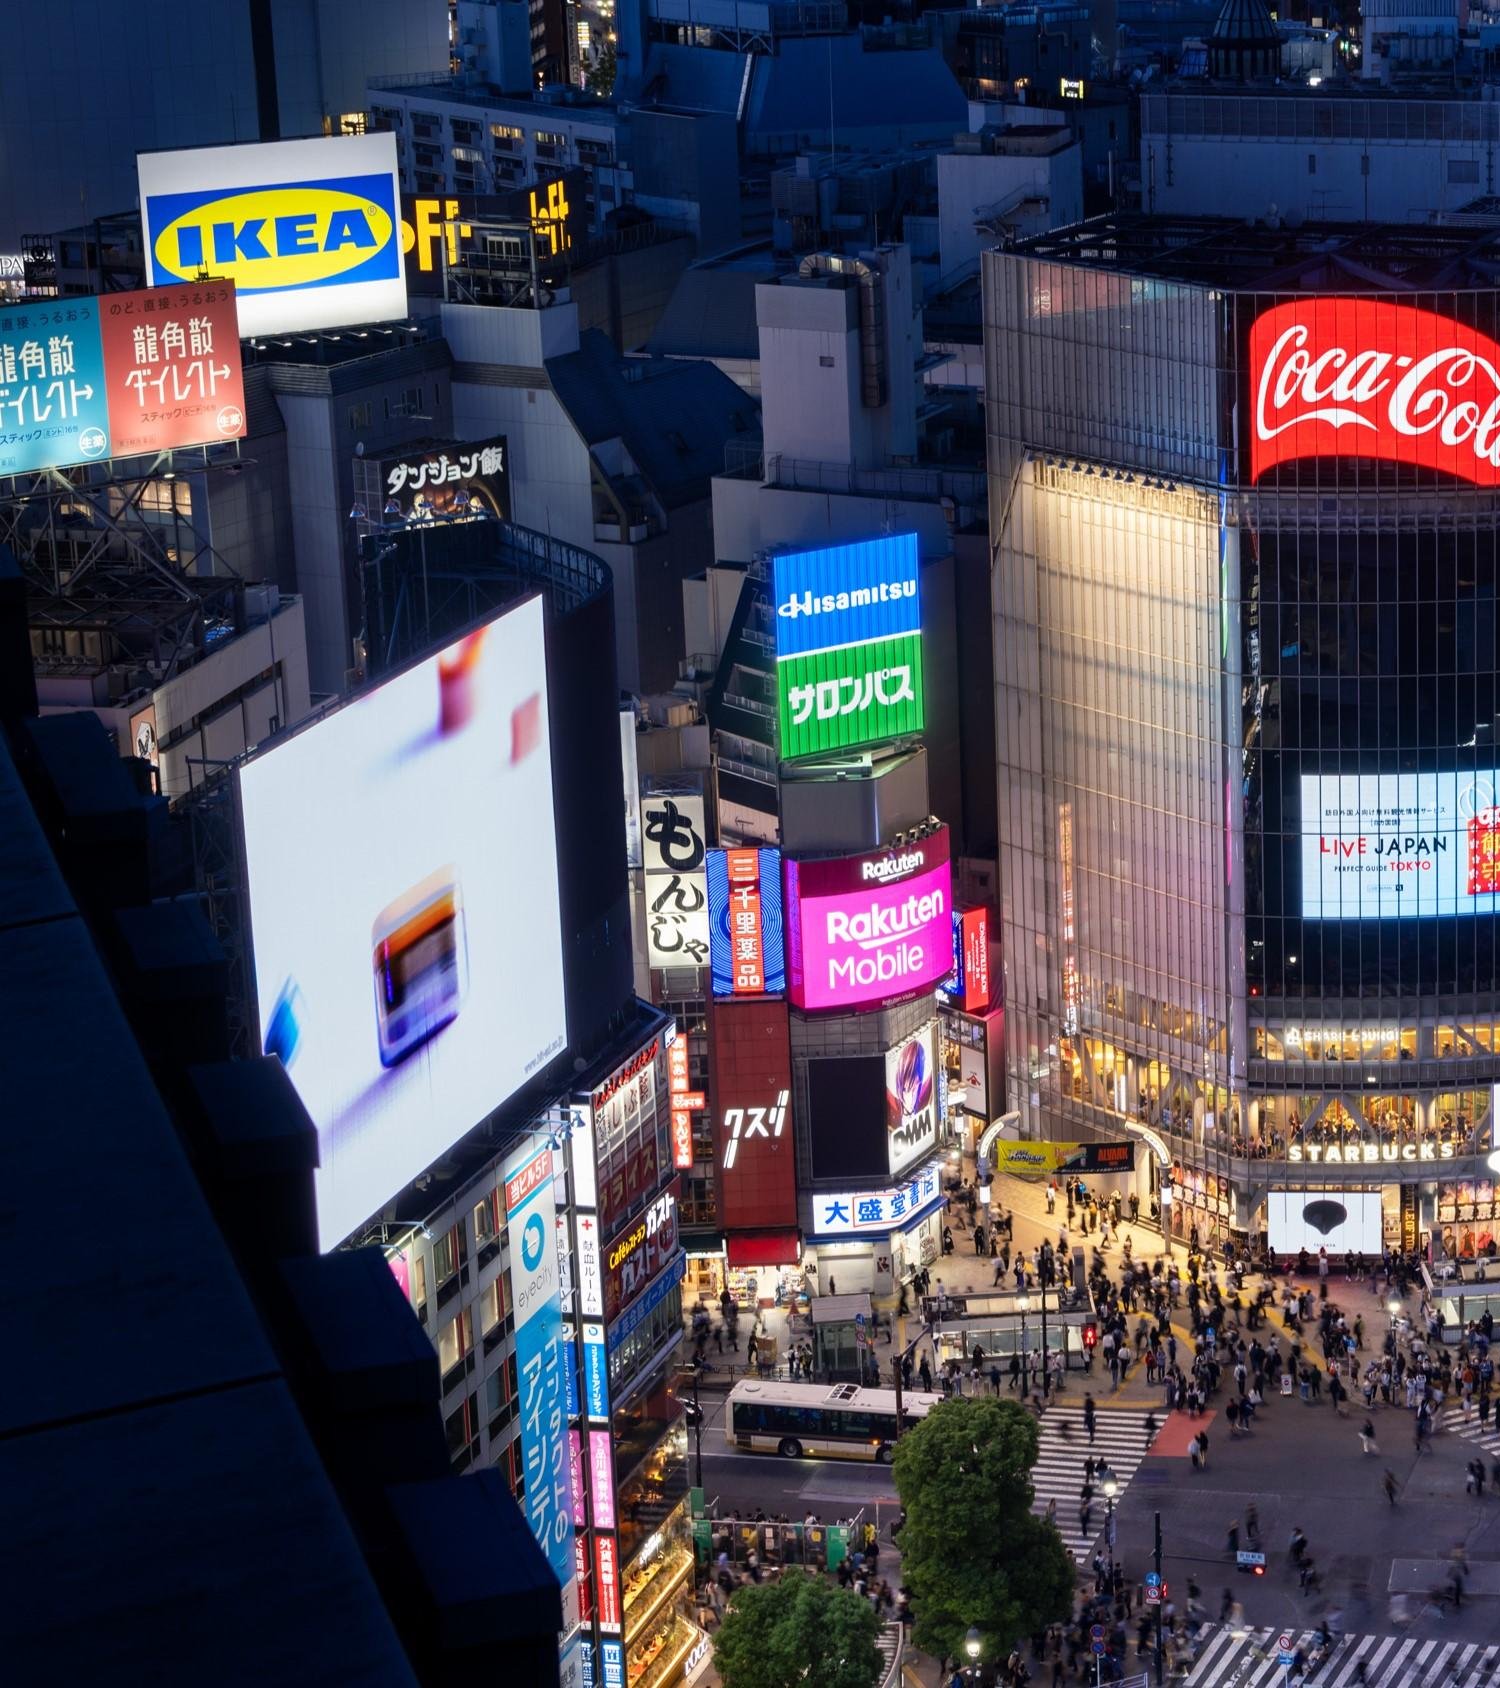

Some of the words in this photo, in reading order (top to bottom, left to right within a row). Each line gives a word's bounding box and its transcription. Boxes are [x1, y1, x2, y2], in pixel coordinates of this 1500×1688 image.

[177, 208, 379, 268] IKEA
[133, 316, 215, 364] 龍角散
[125, 359, 231, 407] ダイレクト
[387, 446, 504, 496] ダンジョン飯
[778, 579, 917, 620] Hisamitsu
[788, 664, 915, 726] サロンパス
[862, 851, 924, 882] Rakuten
[1320, 836, 1367, 858] LIVE
[1374, 835, 1447, 856] JAPAN
[1390, 861, 1431, 872] TOKYO
[645, 800, 710, 963] もんじゃ
[732, 858, 761, 987] 三千里薬品
[827, 889, 944, 949] Rakuten
[828, 944, 924, 989] Mobile
[893, 1107, 933, 1155] DMM
[1289, 1142, 1453, 1162] STARBUCKS
[646, 1192, 675, 1239] ガスト
[825, 1174, 936, 1225] 大盛堂書店
[518, 1265, 553, 1308] eyecity
[583, 1239, 597, 1303] 献血ルーム
[546, 1335, 569, 1544] コンタクトの
